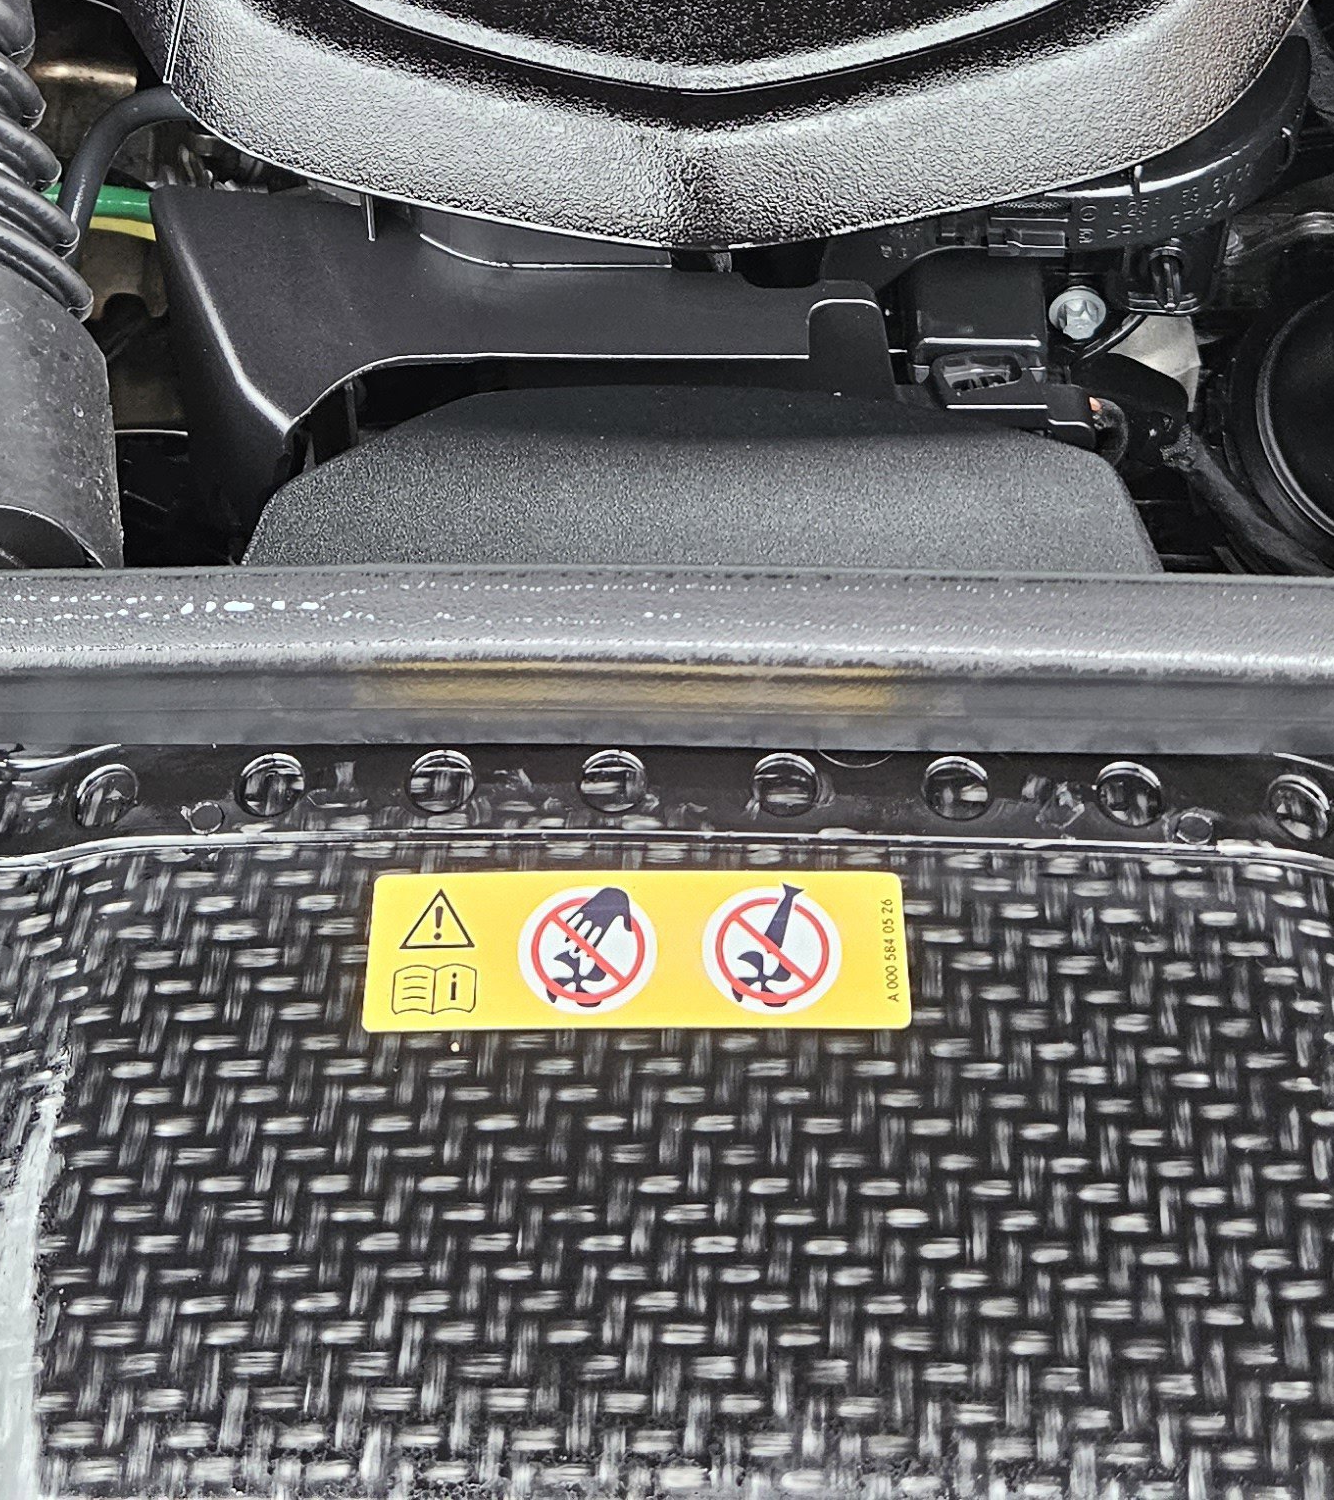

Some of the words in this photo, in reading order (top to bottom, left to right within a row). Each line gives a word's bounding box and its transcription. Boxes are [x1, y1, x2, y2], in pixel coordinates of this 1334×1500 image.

[880, 898, 894, 914] 26
[882, 918, 895, 934] 05
[883, 938, 897, 961] 584
[885, 964, 899, 990] 000
[887, 993, 900, 1003] A
